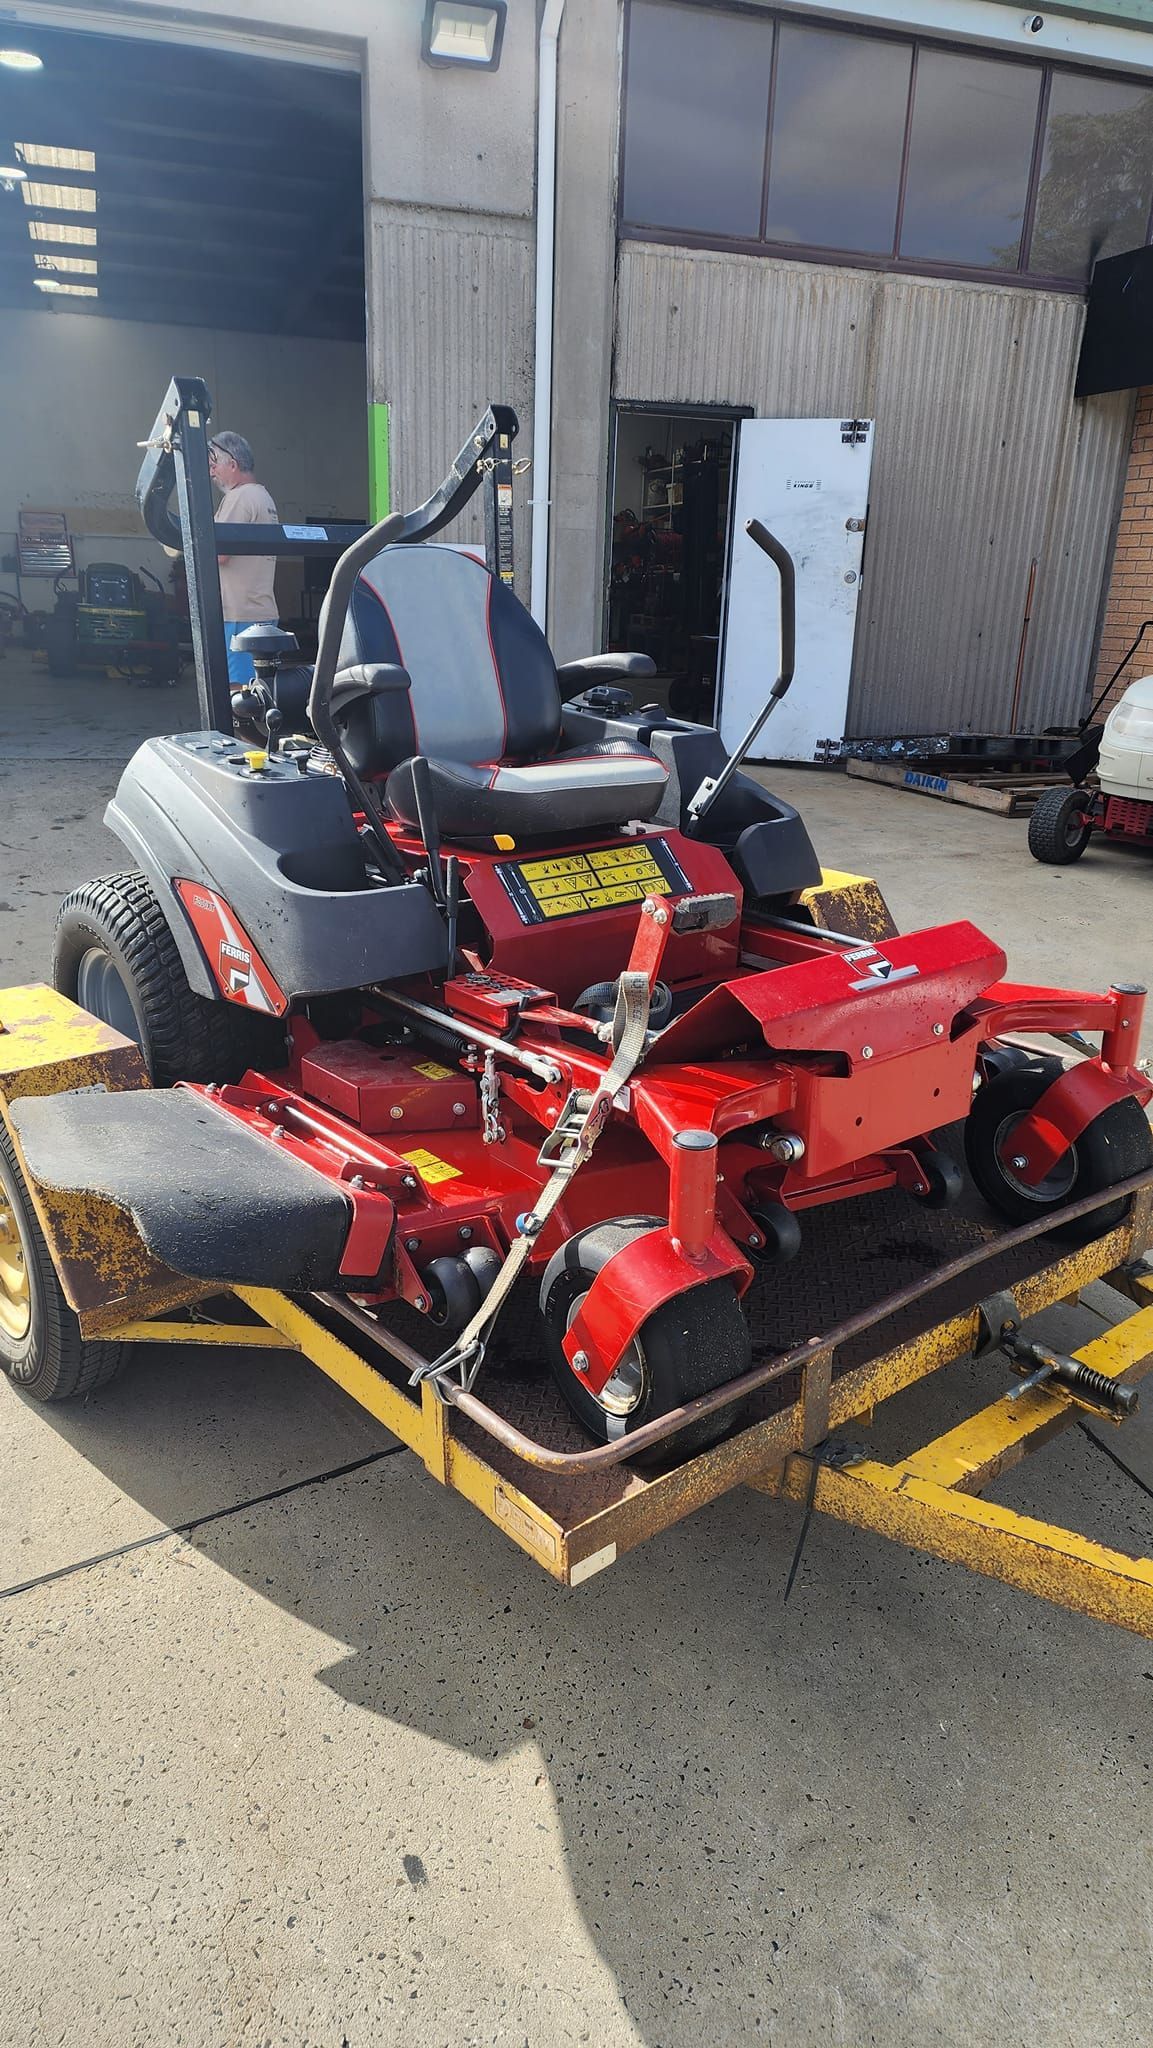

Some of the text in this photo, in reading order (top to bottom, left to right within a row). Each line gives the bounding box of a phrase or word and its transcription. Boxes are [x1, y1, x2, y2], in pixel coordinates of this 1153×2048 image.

[904, 771, 949, 792] DAIKIN
[221, 943, 251, 964] FERRIS
[842, 946, 879, 962] FERRIS
